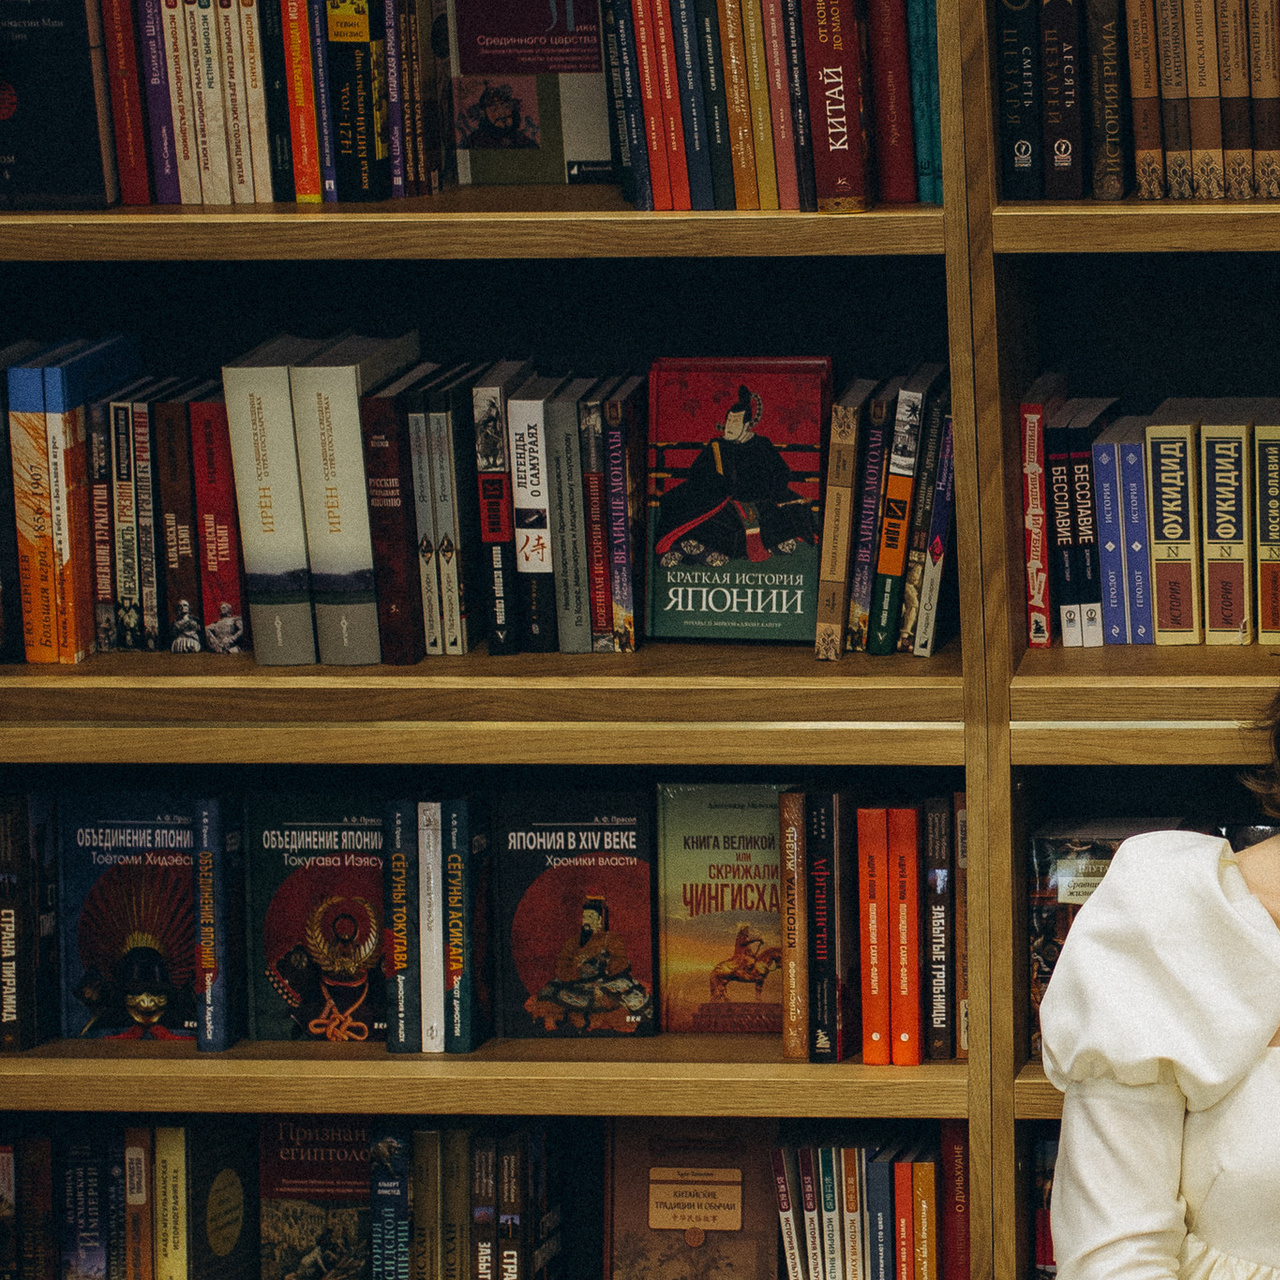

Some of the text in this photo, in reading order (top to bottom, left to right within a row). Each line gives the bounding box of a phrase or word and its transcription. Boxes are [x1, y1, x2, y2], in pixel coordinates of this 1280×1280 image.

[477, 35, 597, 46] Срединного царства
[816, 28, 829, 43] ОТ
[830, 6, 841, 32] МАО
[831, 35, 843, 51] ДО
[819, 65, 849, 151] КИТАЙ
[1022, 46, 1033, 108] СМЕРТЬ
[1062, 42, 1075, 108] ДЕСЯТЬ
[1102, 21, 1121, 172] ИСТОРИЯ РИМА
[514, 432, 527, 488] ЛЕГЕНДЫ
[527, 423, 541, 497] О САМУРАЯХ
[1161, 441, 1184, 539] ФУКИДИД
[1215, 442, 1236, 539] ФУКИДИД
[1269, 446, 1280, 540] ИОСИФ ФЛАВИЙ
[329, 486, 342, 534] ИРЁН
[608, 430, 627, 564] ВЕЛИКИЕ МОГОЛЫ
[857, 429, 883, 562] ВЕЛИКИЕ МОГОЛЫ
[1051, 465, 1072, 546] БЕССЛАВИЕ
[1073, 464, 1094, 544] БЕССЛАВИЕ
[589, 475, 607, 627] ВОЕННАЯ ИСТОРИЯ ЯПОНИИ
[666, 570, 804, 586] КРАТКАЯ ИСТОРИЯ
[663, 586, 804, 614] ЯПОНИИ
[508, 831, 637, 850] ЯПОНИЯ В XIV ВЕКЕ
[545, 855, 637, 868] Хроники власти
[684, 833, 776, 850] КНИГА ВЕЛИКОЙ
[708, 865, 780, 881] СКРИЖАЛИ
[390, 853, 408, 971] СЁГУНЫ ТОКУГАВА
[448, 853, 462, 971] СЁГУНЫ АСИКАГА
[784, 824, 797, 950] КЛЕОПАТРА ЖИЗНЬ
